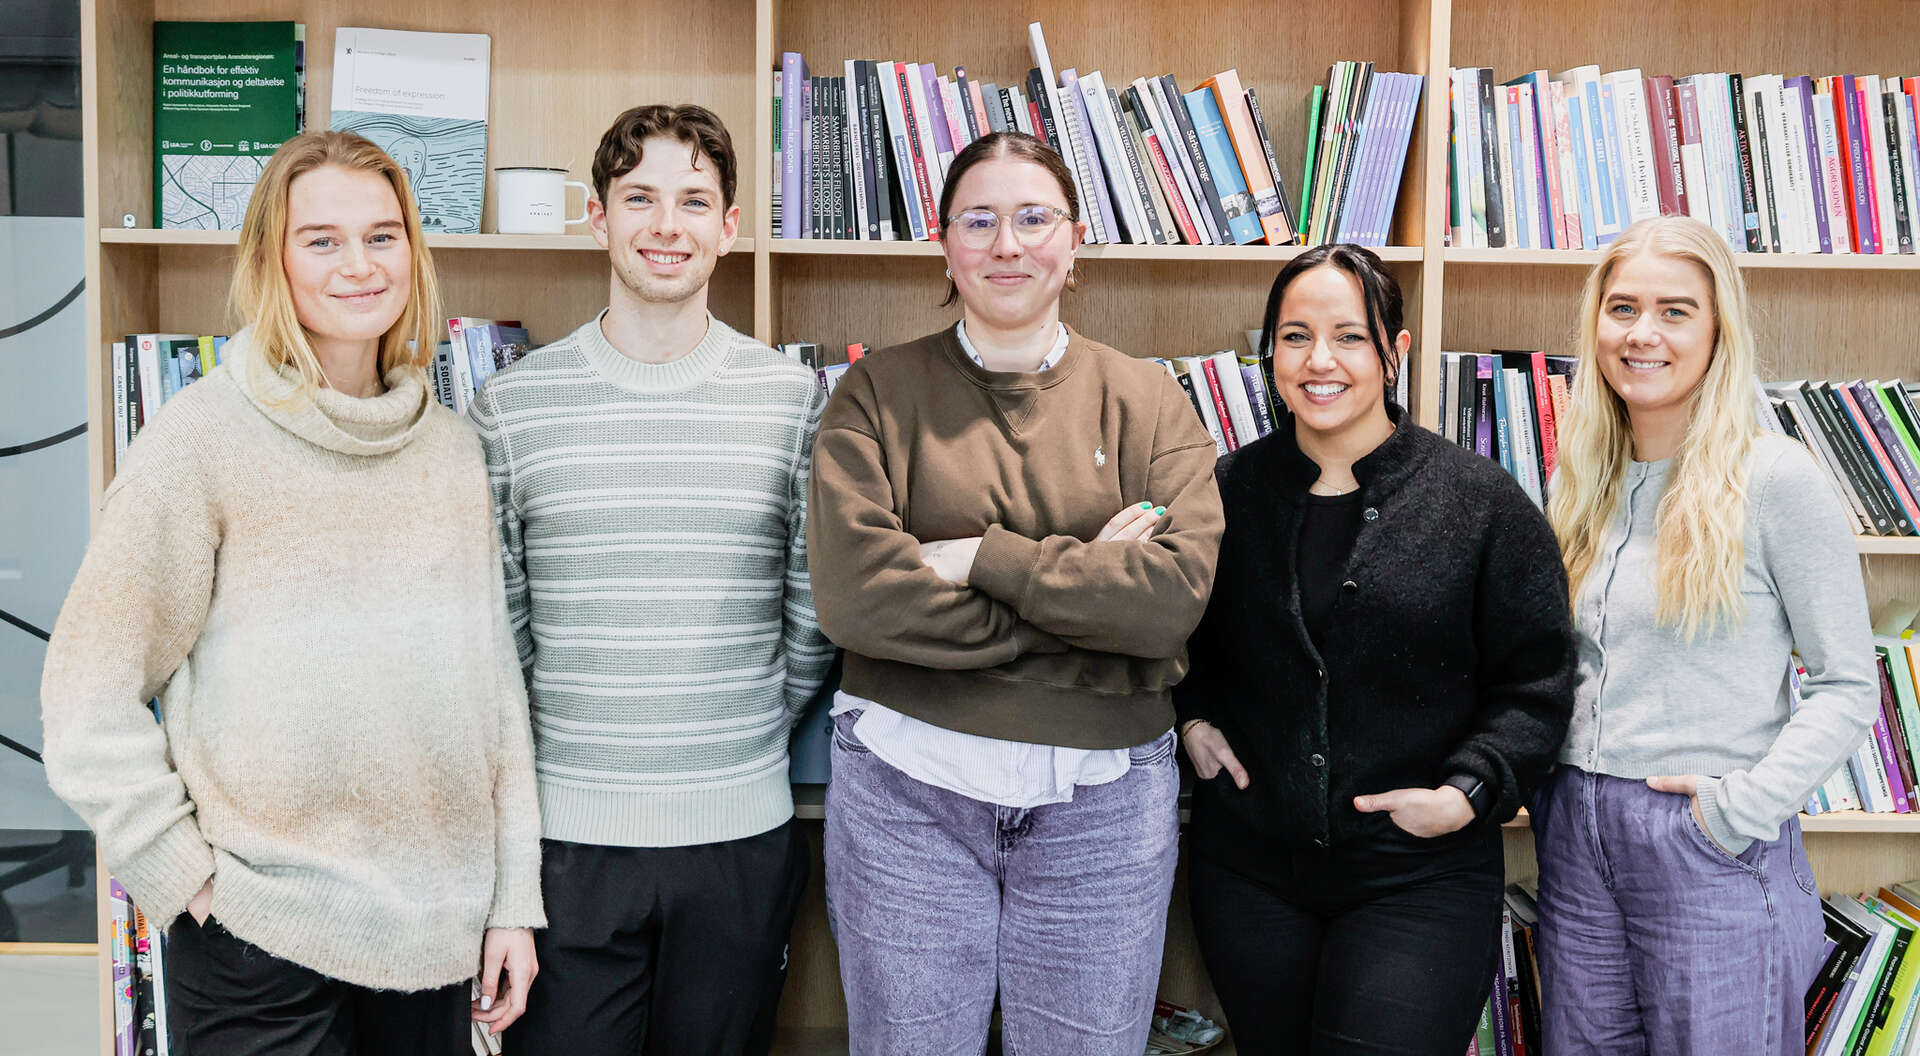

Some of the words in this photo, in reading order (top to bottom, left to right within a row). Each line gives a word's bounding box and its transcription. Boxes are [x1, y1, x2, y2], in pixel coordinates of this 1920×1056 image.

[163, 64, 175, 73] En
[177, 65, 216, 74] håndbok
[216, 65, 228, 74] for
[230, 65, 260, 74] effektiv
[163, 76, 231, 88] kommunikasjon
[232, 79, 243, 88] og
[245, 77, 285, 86] deltakelse
[355, 85, 391, 95] Freedom
[392, 88, 401, 96] of
[402, 90, 446, 101] expression
[163, 88, 166, 96] i
[167, 88, 239, 100] politikkutforming
[1001, 94, 1011, 108] The
[1629, 92, 1638, 108] The
[1005, 108, 1013, 121] new
[874, 130, 880, 138] og
[1044, 117, 1057, 139] Etikk
[1632, 114, 1642, 145] Skills
[1824, 119, 1835, 155] ERSTATT
[812, 115, 820, 177] SAMARBEIDETS
[832, 116, 840, 178] SAMARBEIDETS
[1636, 146, 1643, 158] of
[1738, 129, 1747, 153] AKTIV
[1853, 139, 1861, 162] PERSON
[1186, 129, 1204, 161] Sårbare
[1195, 161, 1211, 184] unge
[1855, 163, 1862, 172] OG
[1637, 160, 1649, 203] Helping
[1828, 157, 1842, 217] AGGRESJONEN
[1856, 172, 1865, 206] PROFESJON
[833, 180, 841, 217] FILOSOFI
[440, 365, 452, 401] SOCIALT
[1250, 374, 1262, 393] STEIN
[1255, 392, 1268, 416] RINGEN
[1890, 444, 1912, 478] UNIVERSAL
[1881, 955, 1898, 989] Place-Based
[1871, 987, 1887, 1014] Education
[1866, 1018, 1874, 1029] the
[1859, 1028, 1871, 1046] Global
